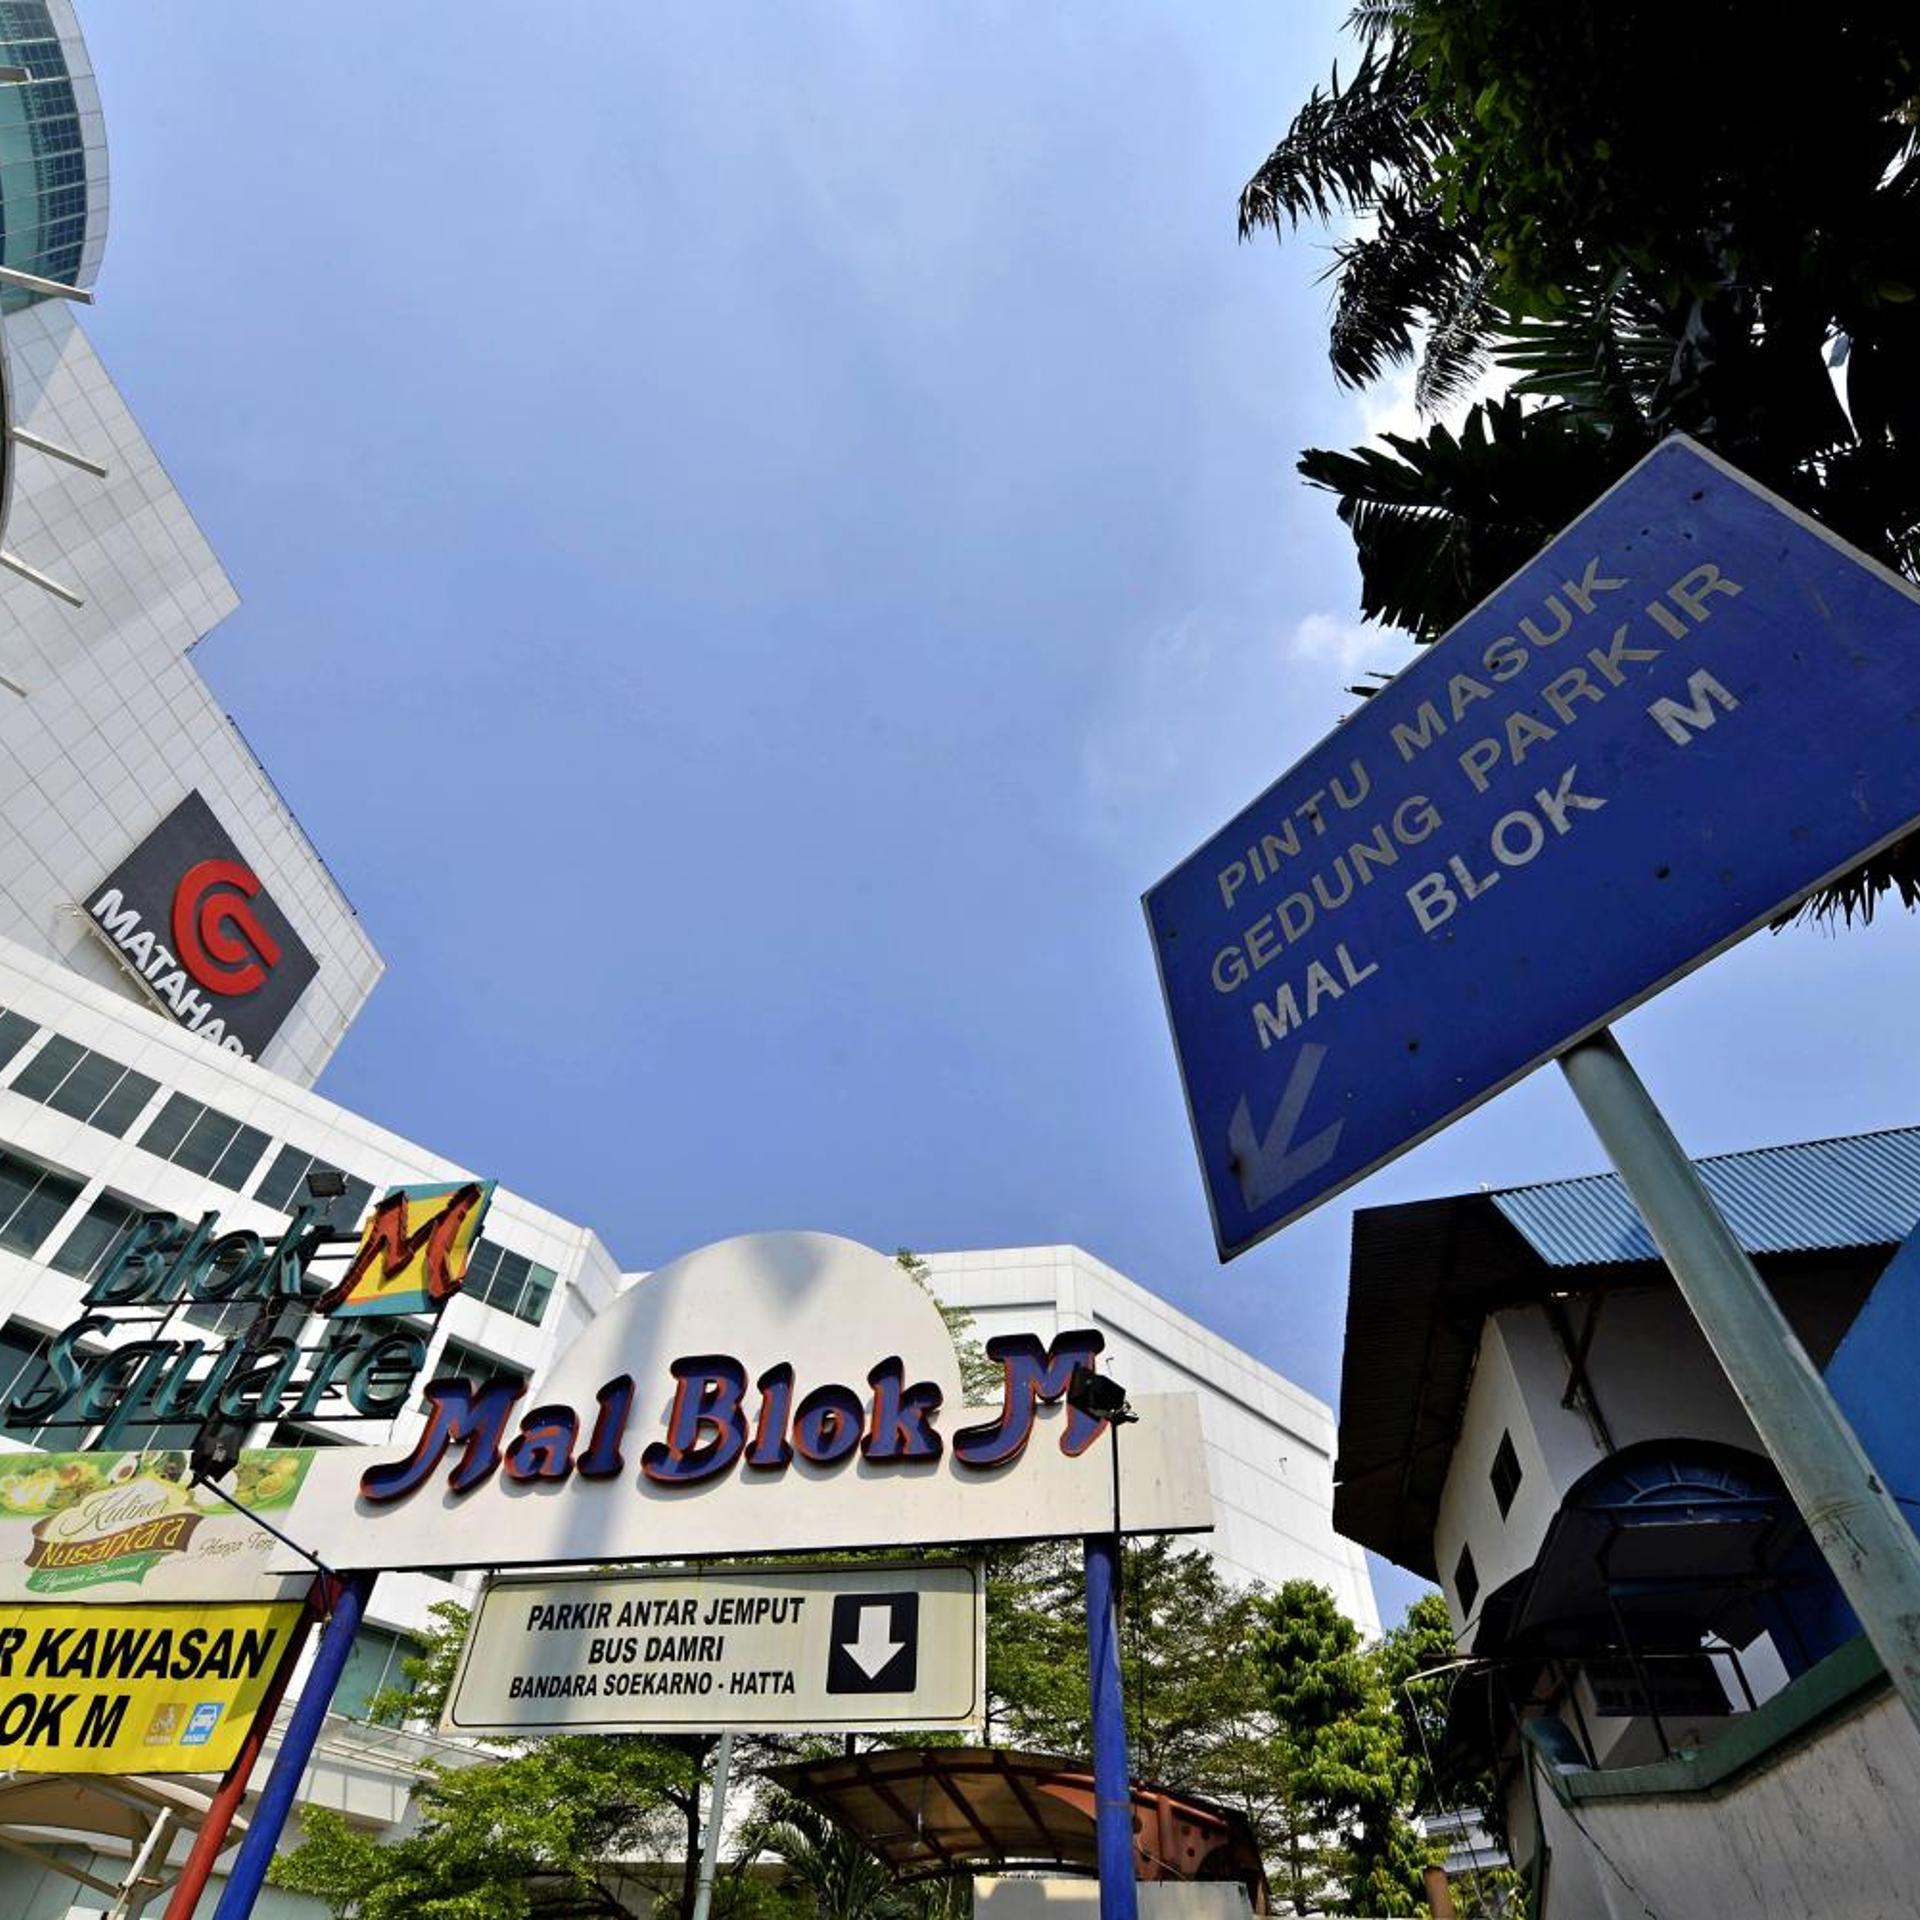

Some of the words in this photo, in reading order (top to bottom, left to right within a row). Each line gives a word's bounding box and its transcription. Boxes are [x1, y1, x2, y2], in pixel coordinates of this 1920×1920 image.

[1211, 795, 1443, 993] GEDUNG
[1458, 563, 1744, 794] PARKIR
[1217, 758, 1371, 910] PINTU
[1389, 555, 1630, 763] MASUK
[1252, 943, 1380, 1050] MAL
[1405, 763, 1608, 933] BLOK
[1647, 668, 1741, 747] M
[91, 889, 254, 1063] MATAHAR
[82, 1203, 334, 1306] Blok
[314, 1181, 483, 1319] M
[3, 1315, 428, 1452] Square
[360, 1373, 634, 1501] Mal
[641, 1354, 945, 1484] Blok
[953, 1329, 1107, 1468] M
[35, 1517, 186, 1569] Nusantara
[25, 1628, 278, 1680] KAWASAN
[527, 1602, 611, 1632] PARKIR
[617, 1600, 699, 1628] ANTAR
[703, 1597, 805, 1626] JEMPUT
[588, 1638, 637, 1665] BUS
[644, 1636, 725, 1663] DAMRI
[74, 1695, 131, 1749] M
[509, 1674, 598, 1699] BANDARA
[603, 1672, 713, 1697] SOEKARNO
[730, 1671, 796, 1696] HATTA
